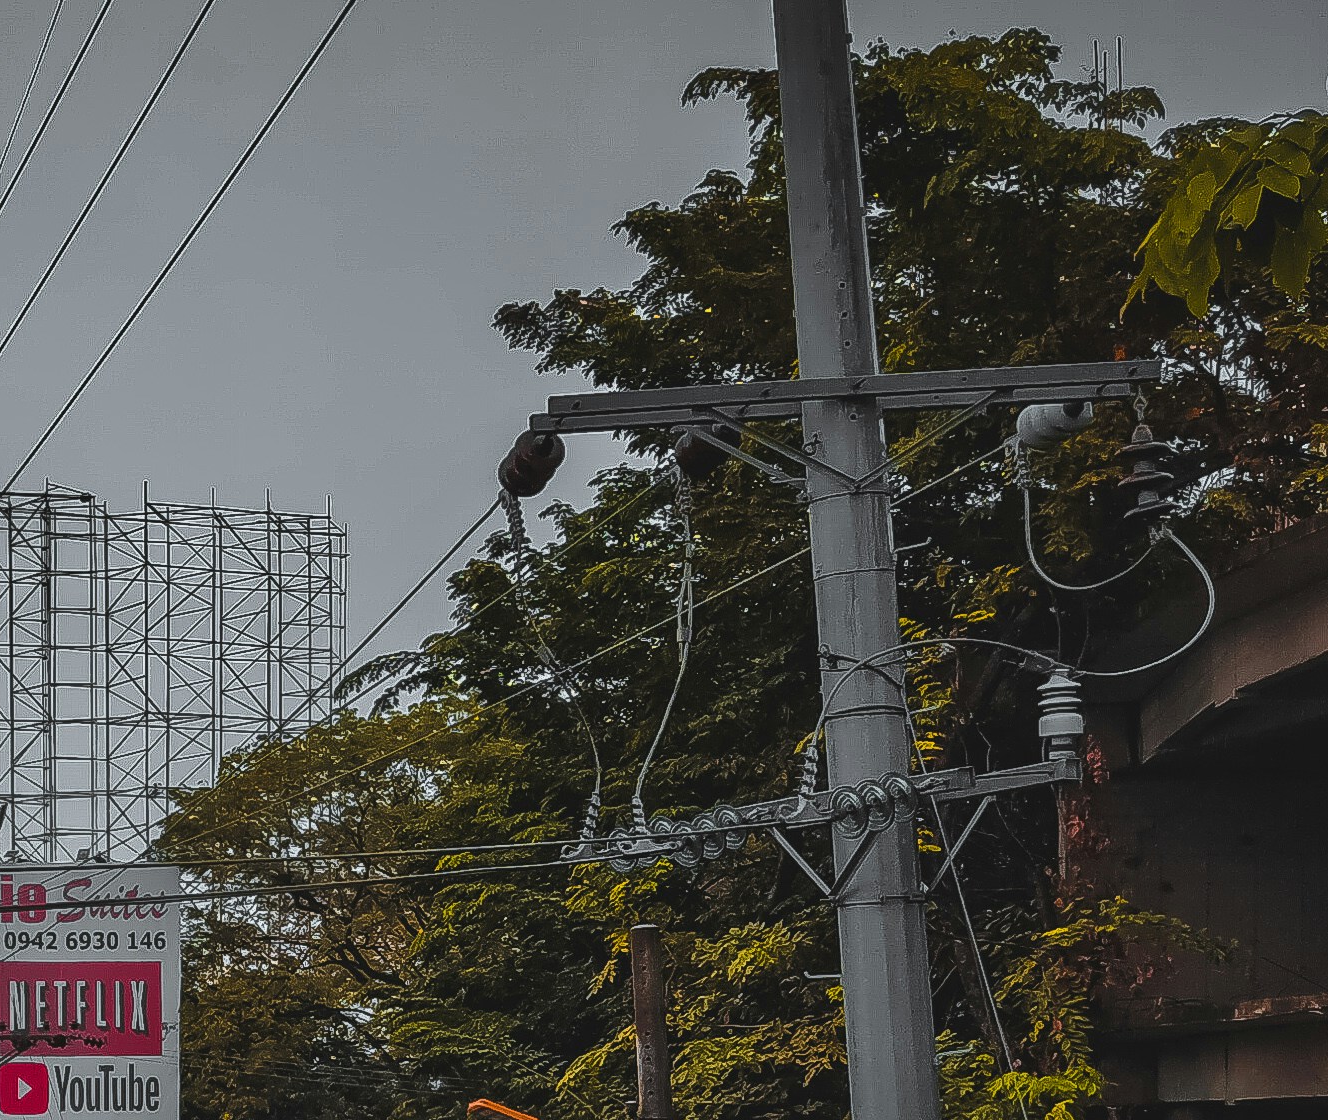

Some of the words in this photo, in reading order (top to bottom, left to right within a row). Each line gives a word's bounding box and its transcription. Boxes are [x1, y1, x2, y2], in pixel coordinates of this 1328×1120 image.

[57, 878, 169, 924] Suites
[4, 931, 58, 951] 0942
[65, 931, 119, 951] 6930
[127, 931, 167, 951] 146
[8, 979, 148, 1036] NETFLIX
[53, 1063, 160, 1113] YouTube
